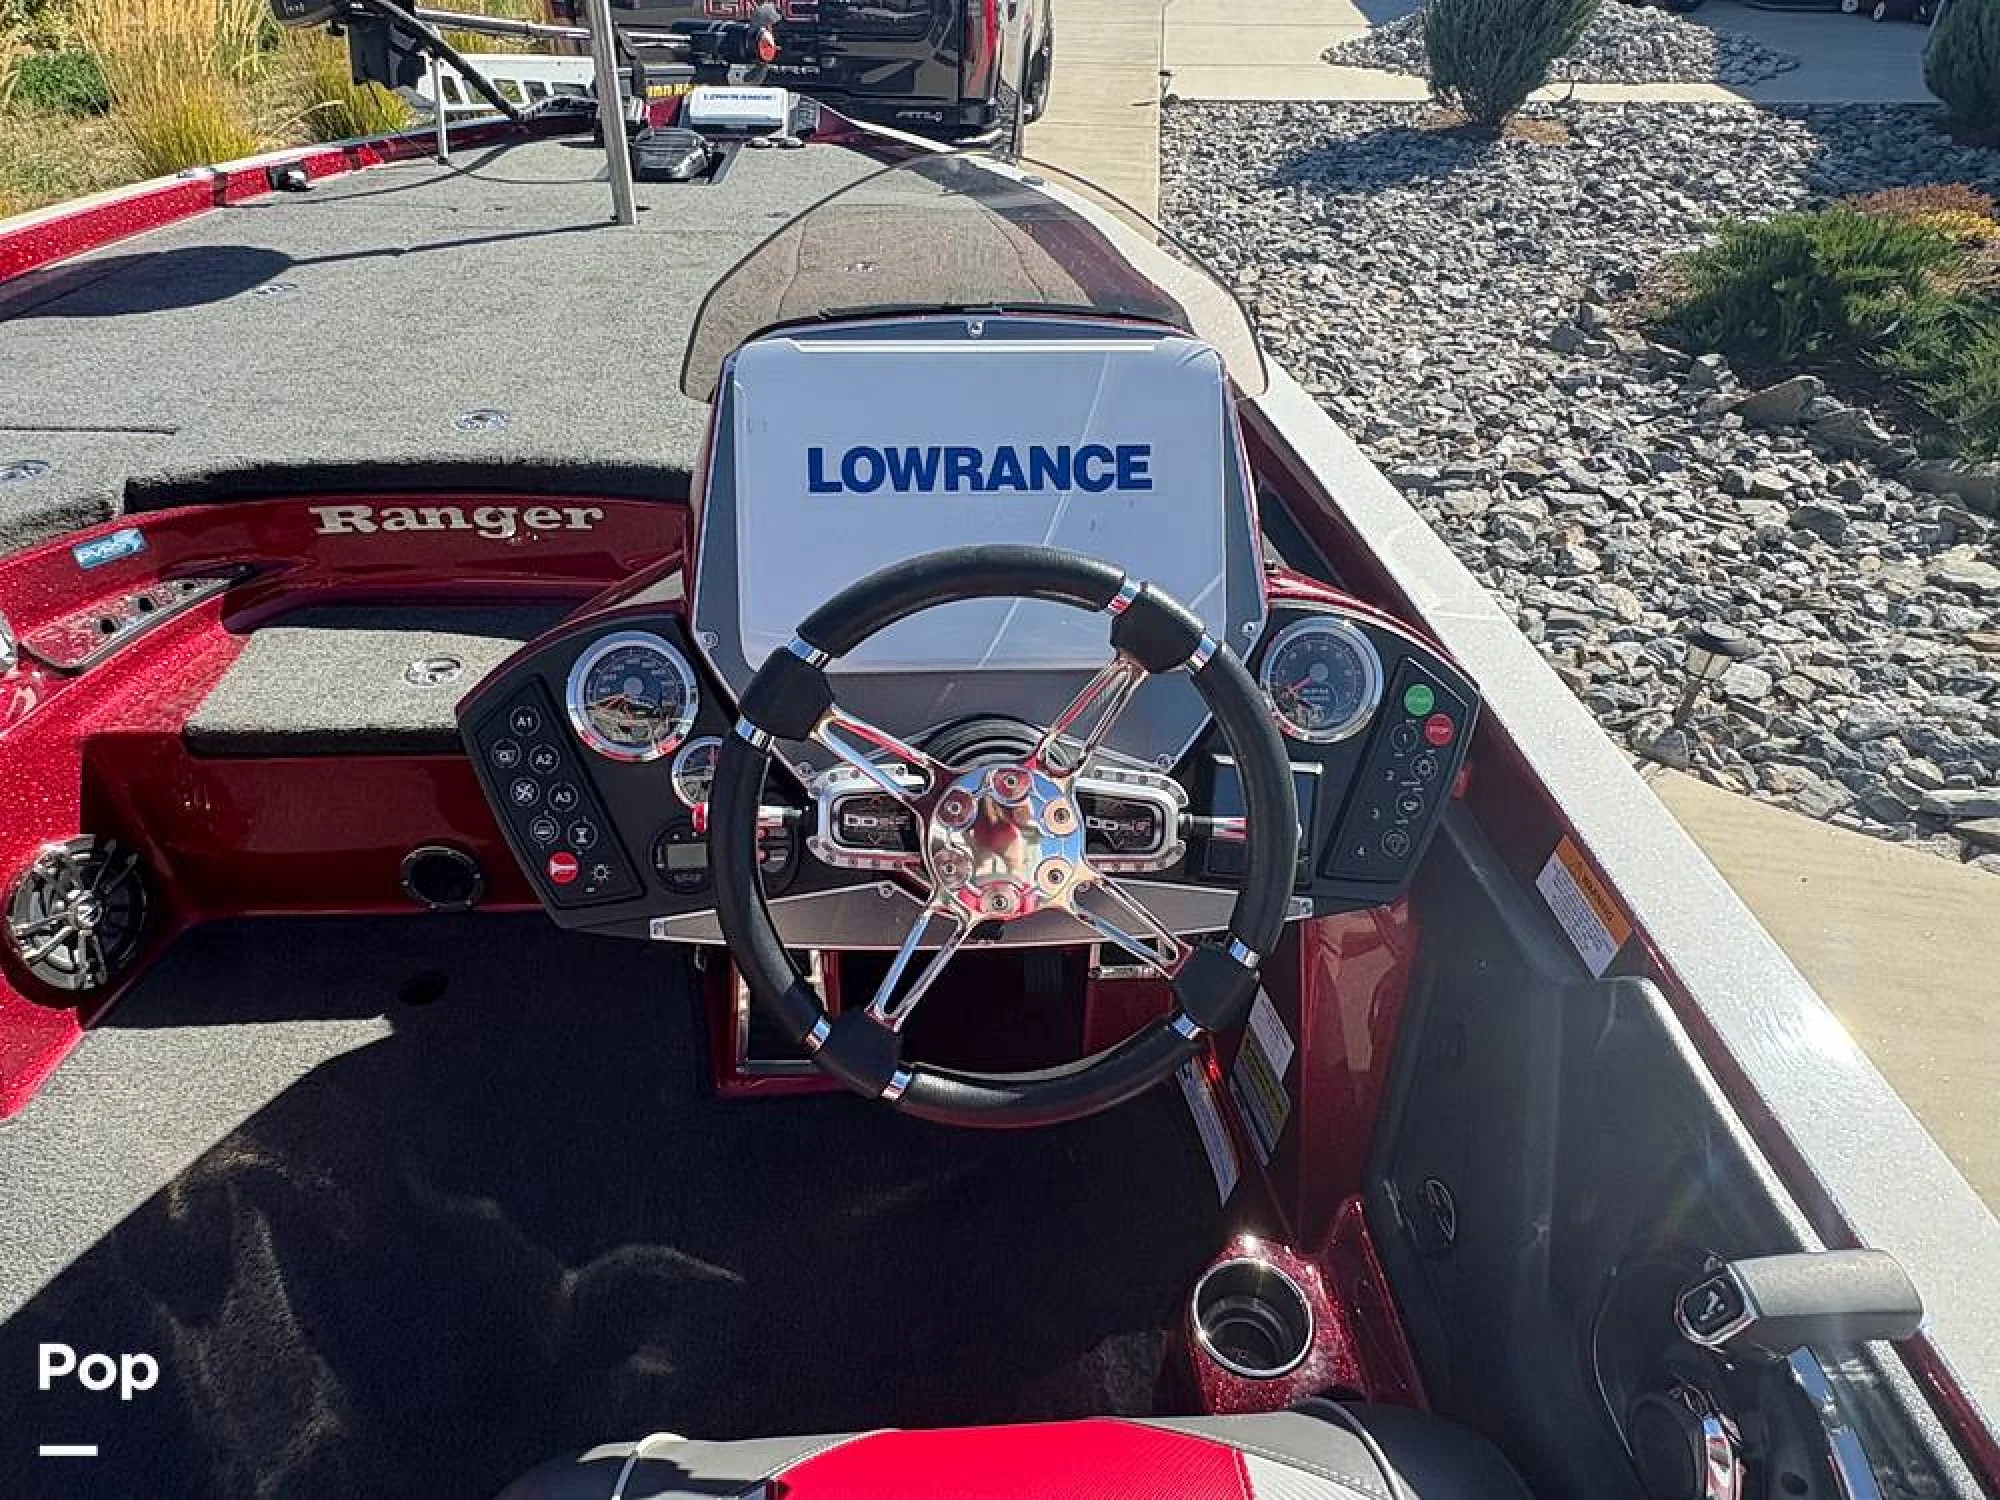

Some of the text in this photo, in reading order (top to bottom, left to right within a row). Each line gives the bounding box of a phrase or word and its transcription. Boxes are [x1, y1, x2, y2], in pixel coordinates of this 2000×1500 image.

[807, 444, 1152, 493] LOWRANCE
[308, 505, 605, 538] Ranger
[517, 716, 532, 727] A1
[535, 753, 553, 765] A2
[555, 792, 571, 803] A3
